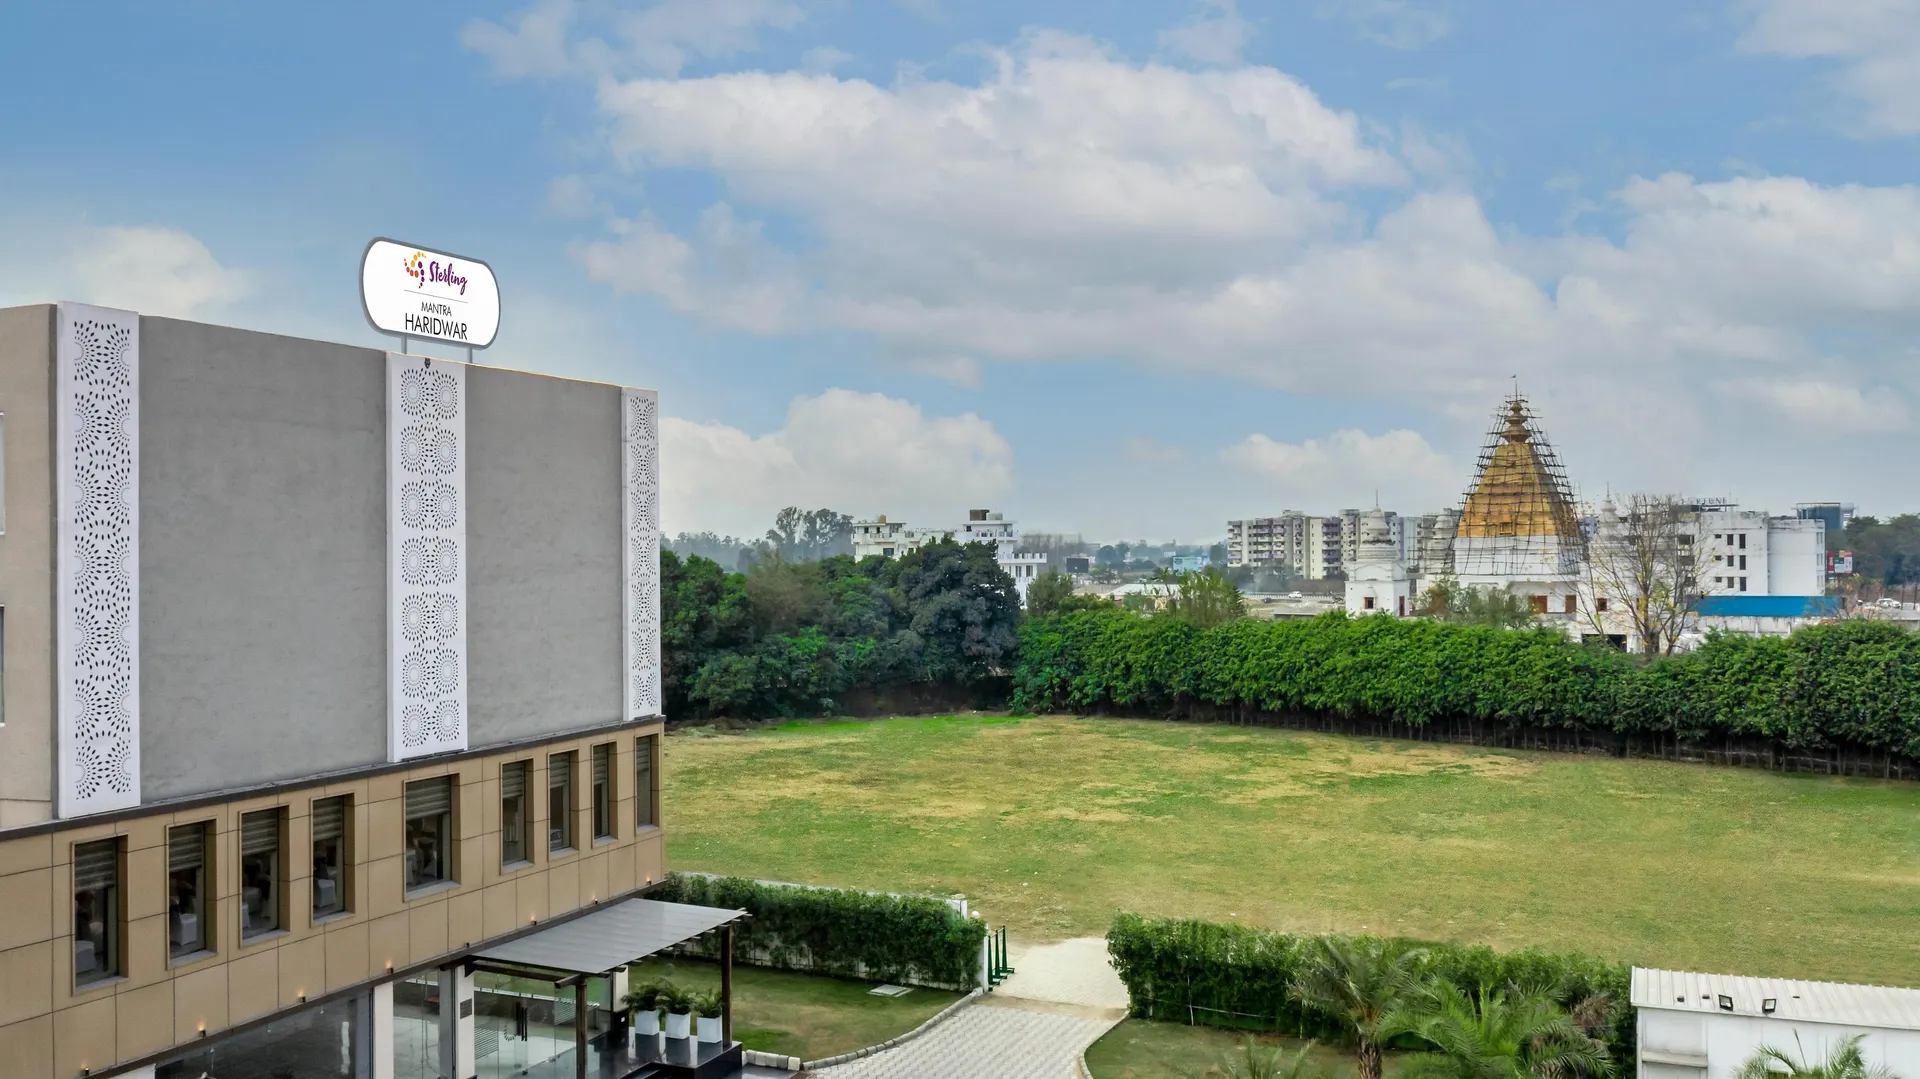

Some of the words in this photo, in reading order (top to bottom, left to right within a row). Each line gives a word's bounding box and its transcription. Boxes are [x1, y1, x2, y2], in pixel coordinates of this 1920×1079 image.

[429, 261, 468, 295] Sterling
[421, 302, 452, 316] MANTRA
[405, 313, 468, 340] HARIDWAR
